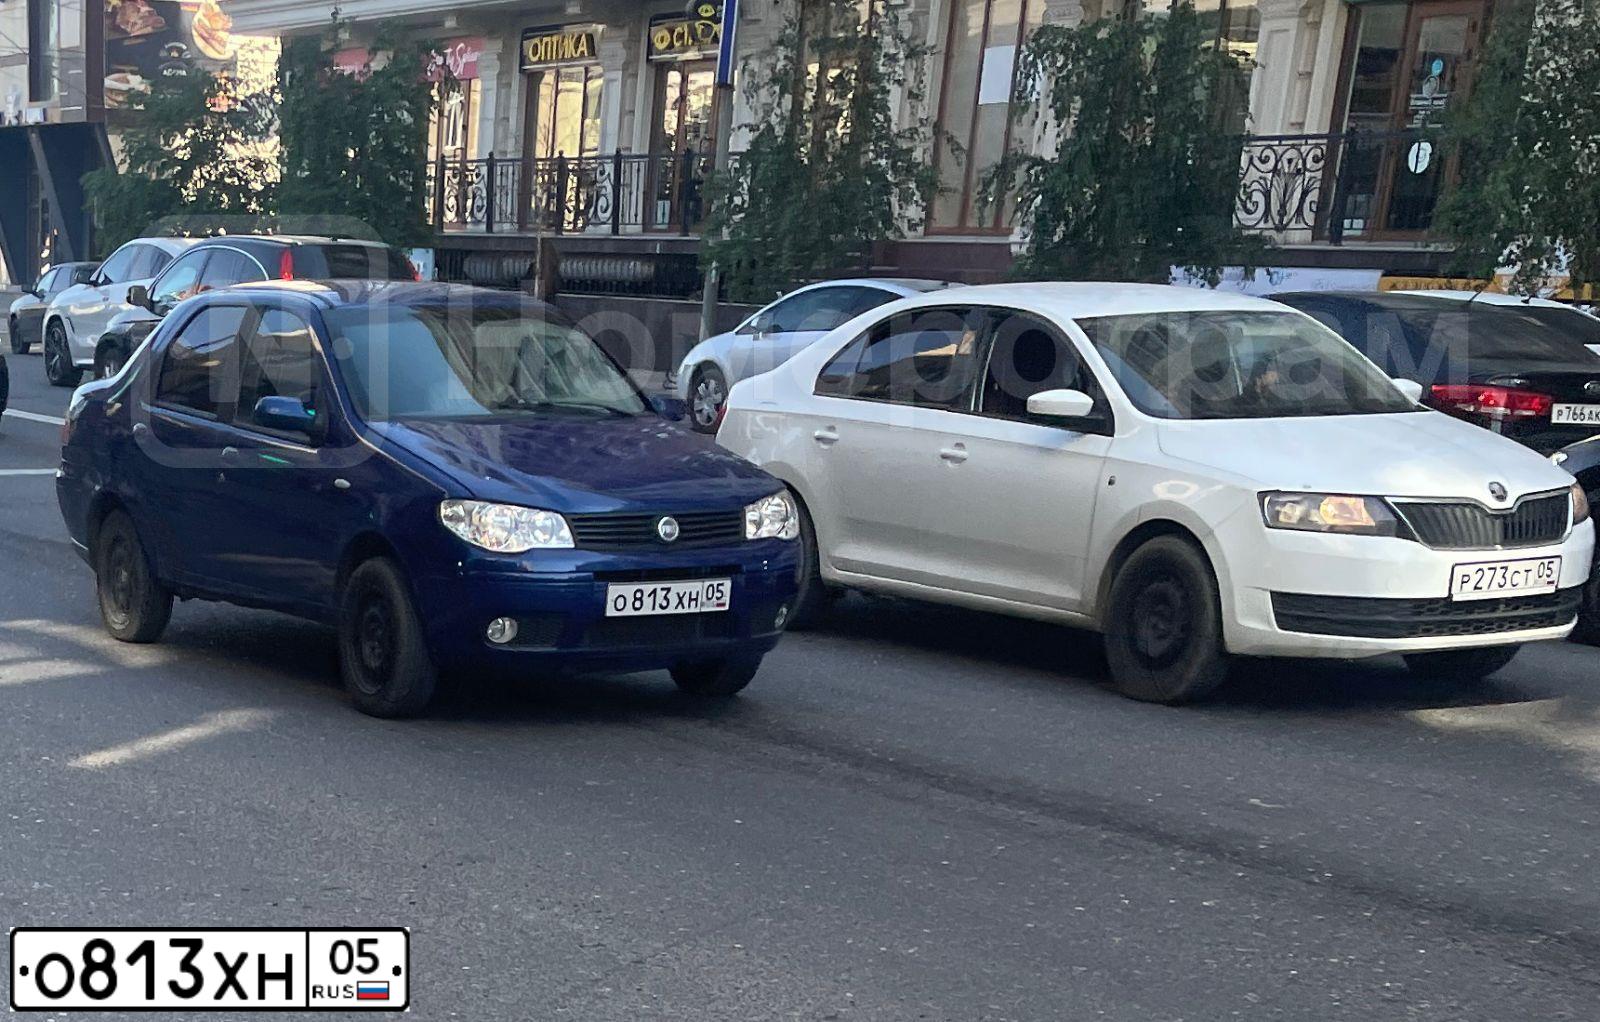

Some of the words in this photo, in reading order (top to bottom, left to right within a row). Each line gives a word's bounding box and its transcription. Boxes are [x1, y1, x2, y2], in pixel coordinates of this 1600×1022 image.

[528, 33, 589, 62] ОПТИКА
[1459, 566, 1533, 592] Р273СТ
[1537, 560, 1555, 579] 05
[613, 586, 700, 612] О813ХН
[705, 582, 725, 601] 05
